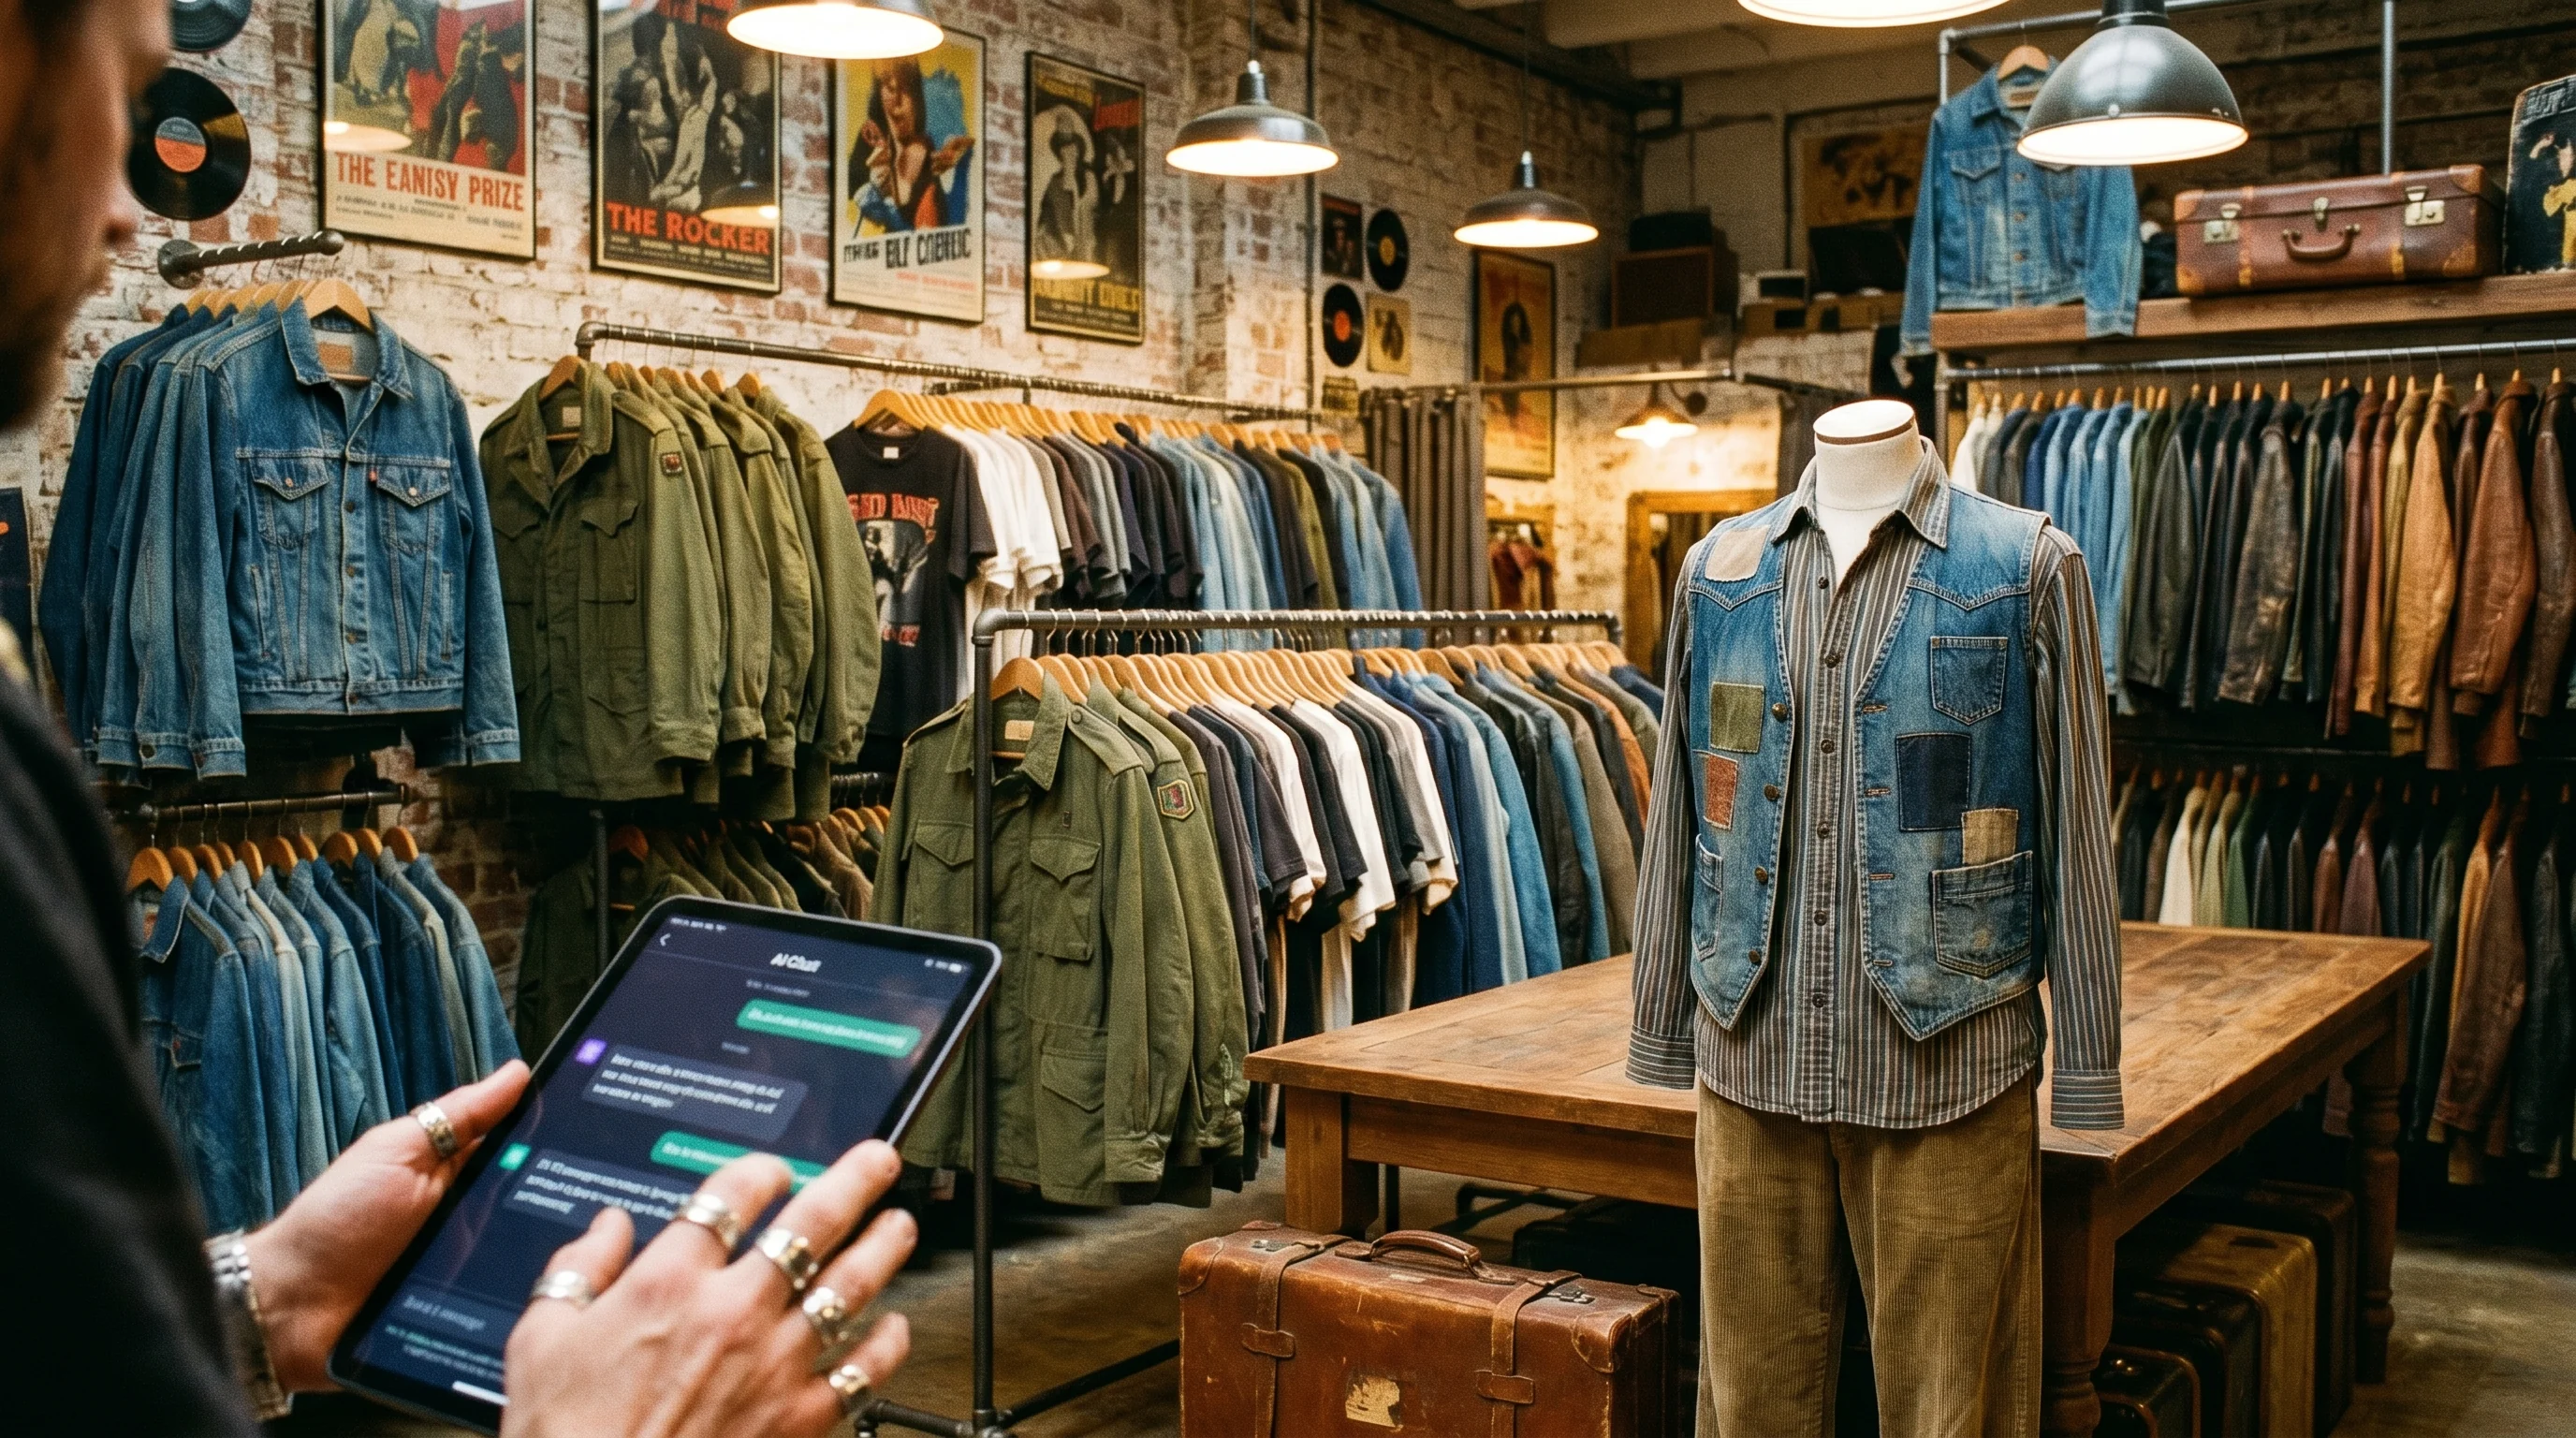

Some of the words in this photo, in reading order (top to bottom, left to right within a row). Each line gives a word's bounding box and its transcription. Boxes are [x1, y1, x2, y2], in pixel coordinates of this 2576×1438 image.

[335, 152, 376, 187] THE
[469, 175, 524, 212] PRIZE
[607, 201, 658, 236] THE
[666, 211, 769, 255] ROCKER
